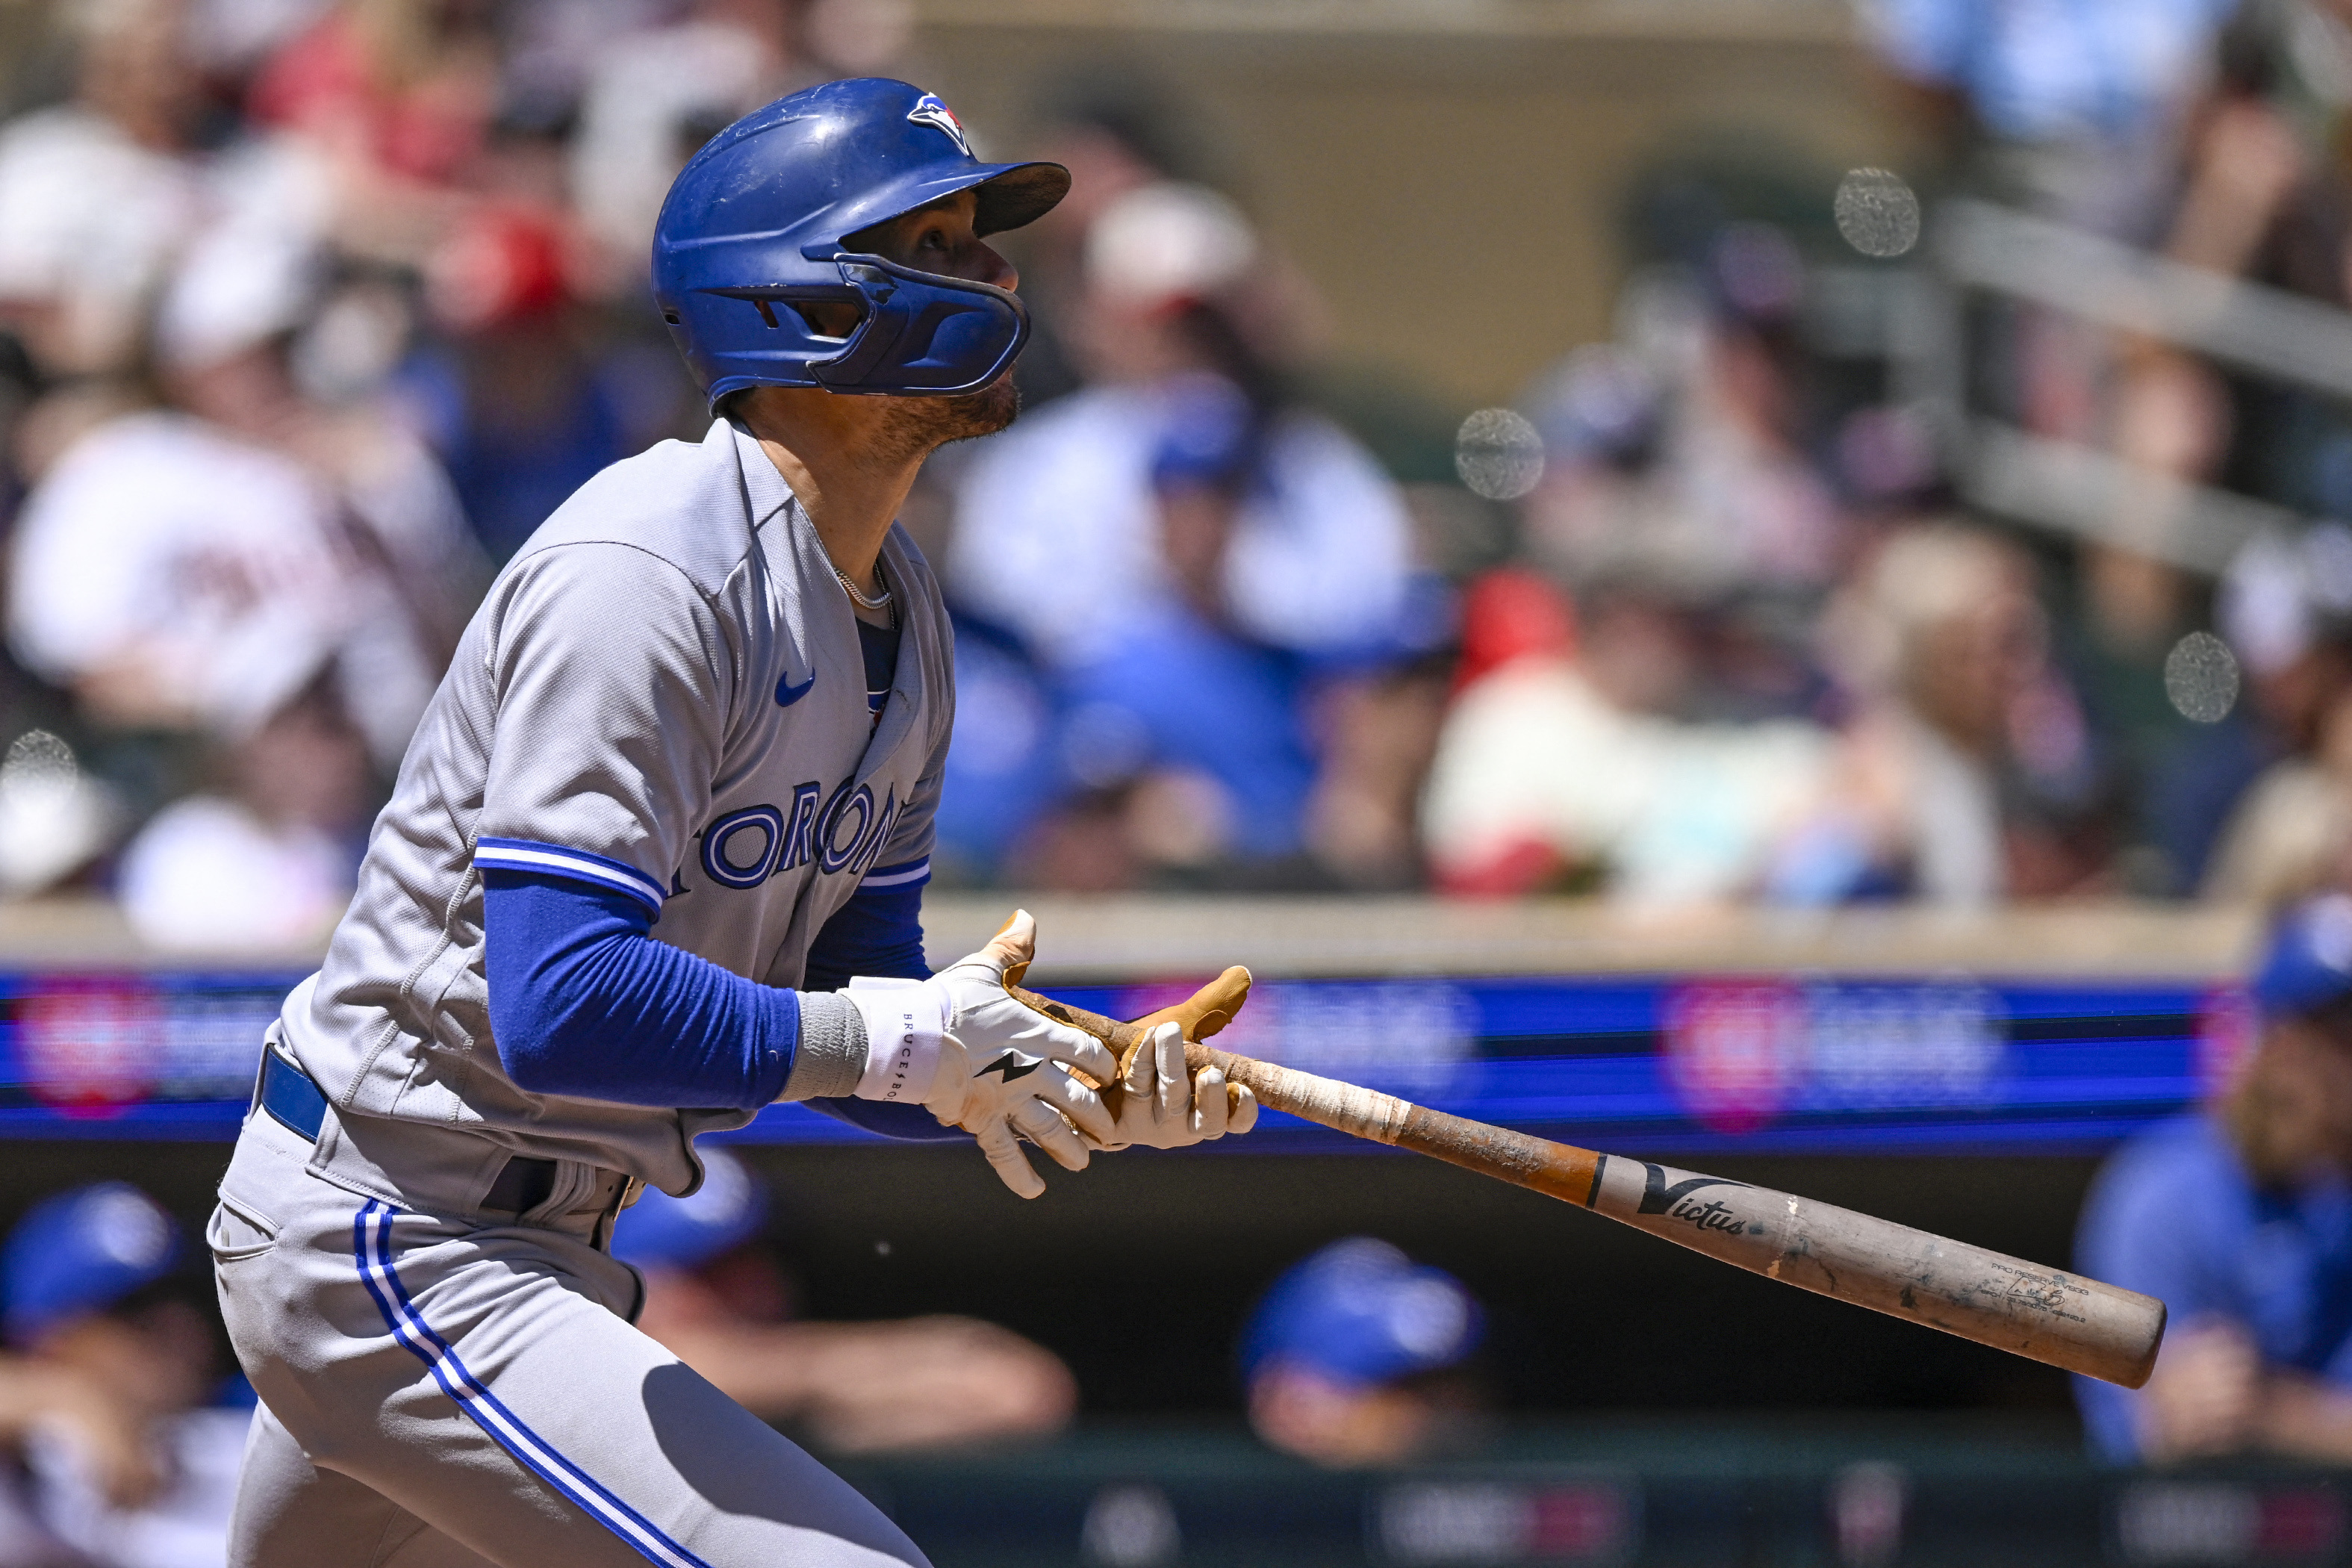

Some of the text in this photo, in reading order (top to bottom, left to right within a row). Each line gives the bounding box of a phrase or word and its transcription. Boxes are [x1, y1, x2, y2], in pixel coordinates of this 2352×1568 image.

[665, 775, 906, 900] ORON
[899, 1013, 913, 1068] BRUCE
[1637, 1162, 1755, 1234] Victus
[1980, 1289, 2002, 1298] BIRCH
[1991, 1263, 2089, 1295] PRO RESERVE VB33
